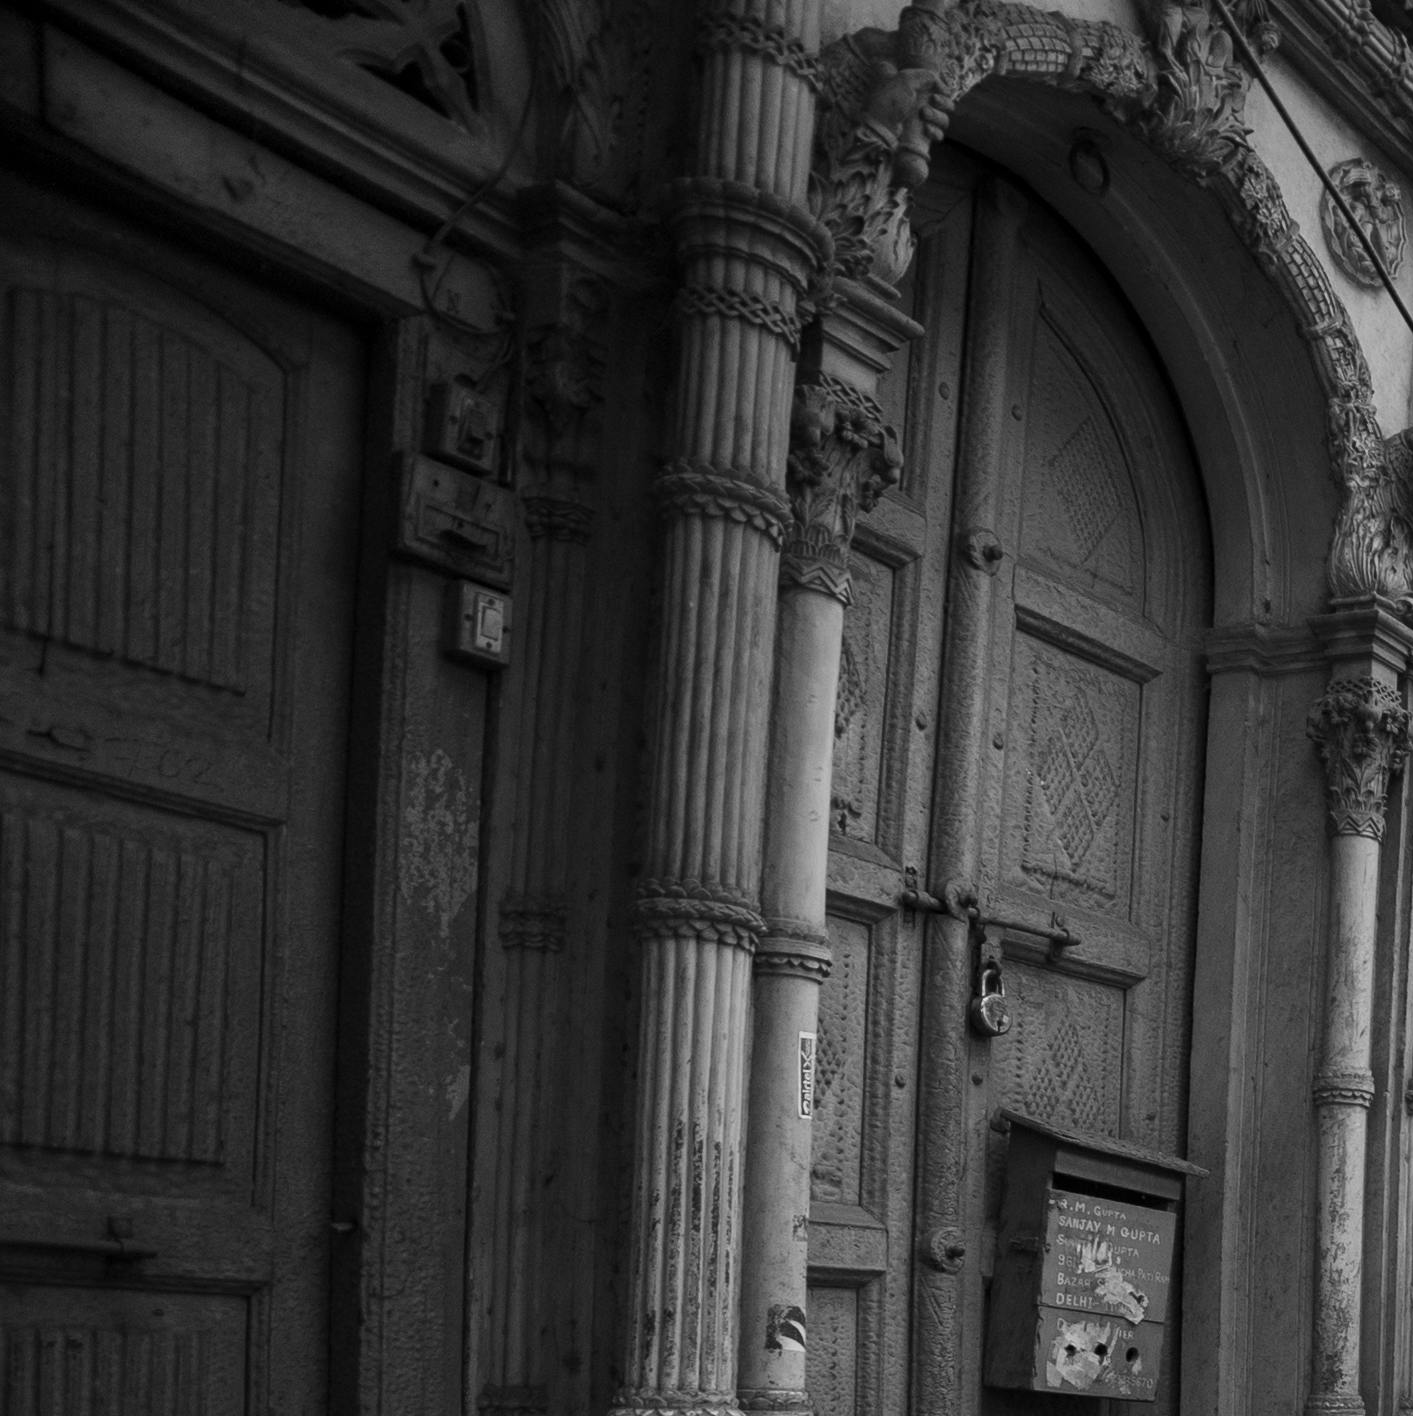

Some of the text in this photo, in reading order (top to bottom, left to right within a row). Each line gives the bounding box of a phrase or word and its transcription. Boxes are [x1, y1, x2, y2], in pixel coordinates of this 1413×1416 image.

[1094, 1206, 1127, 1220] GUPTA
[1059, 1215, 1101, 1232] SANJAY
[1106, 1224, 1116, 1236] M
[1120, 1227, 1161, 1245] GUPTA
